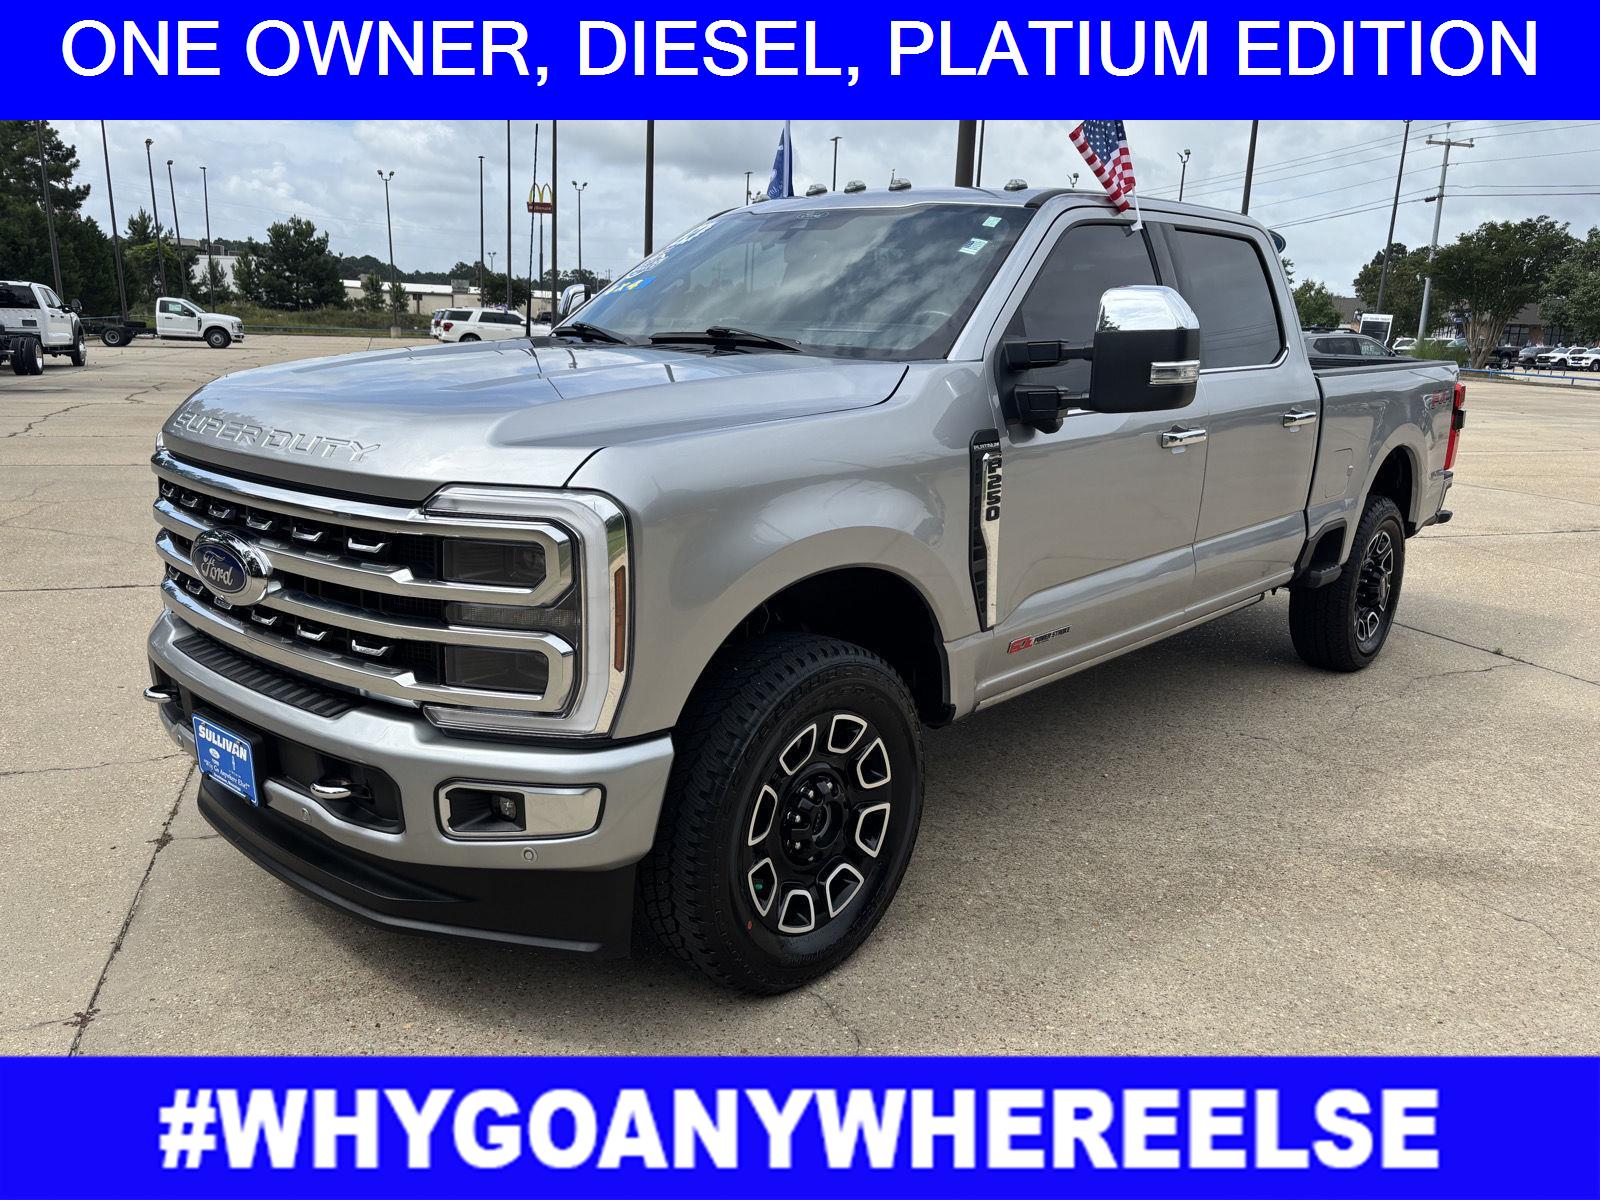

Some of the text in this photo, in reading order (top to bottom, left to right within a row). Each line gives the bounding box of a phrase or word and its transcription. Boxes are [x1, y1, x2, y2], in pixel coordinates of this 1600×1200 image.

[173, 411, 381, 463] SUPER DUTY
[200, 550, 235, 586] Ford
[198, 723, 248, 762] SULLIVAN
